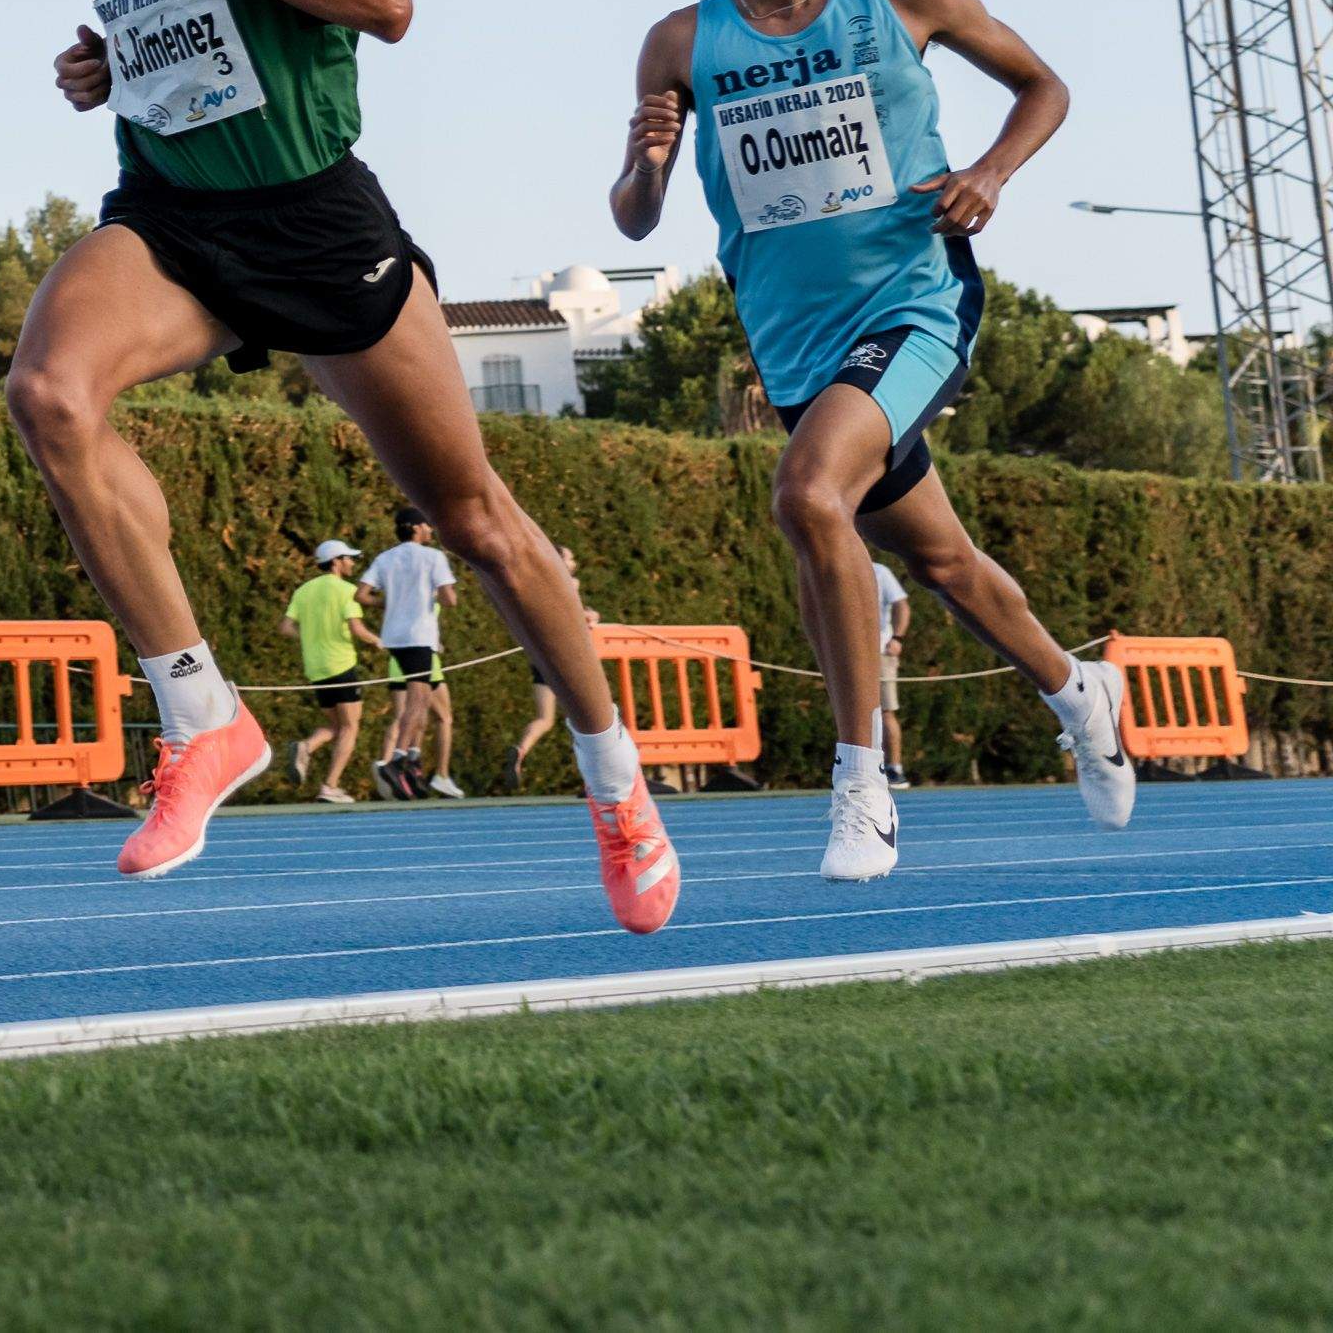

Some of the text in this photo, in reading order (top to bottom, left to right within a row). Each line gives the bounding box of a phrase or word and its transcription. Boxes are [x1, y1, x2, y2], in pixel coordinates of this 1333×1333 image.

[114, 12, 225, 82] S.Jiménez
[212, 51, 233, 76] 3
[712, 48, 842, 96] nerja
[718, 80, 865, 127] DESAFÍO NERJA 2020
[740, 113, 869, 175] O.Oumaiz
[857, 154, 871, 176] 1
[170, 662, 203, 678] adidas
